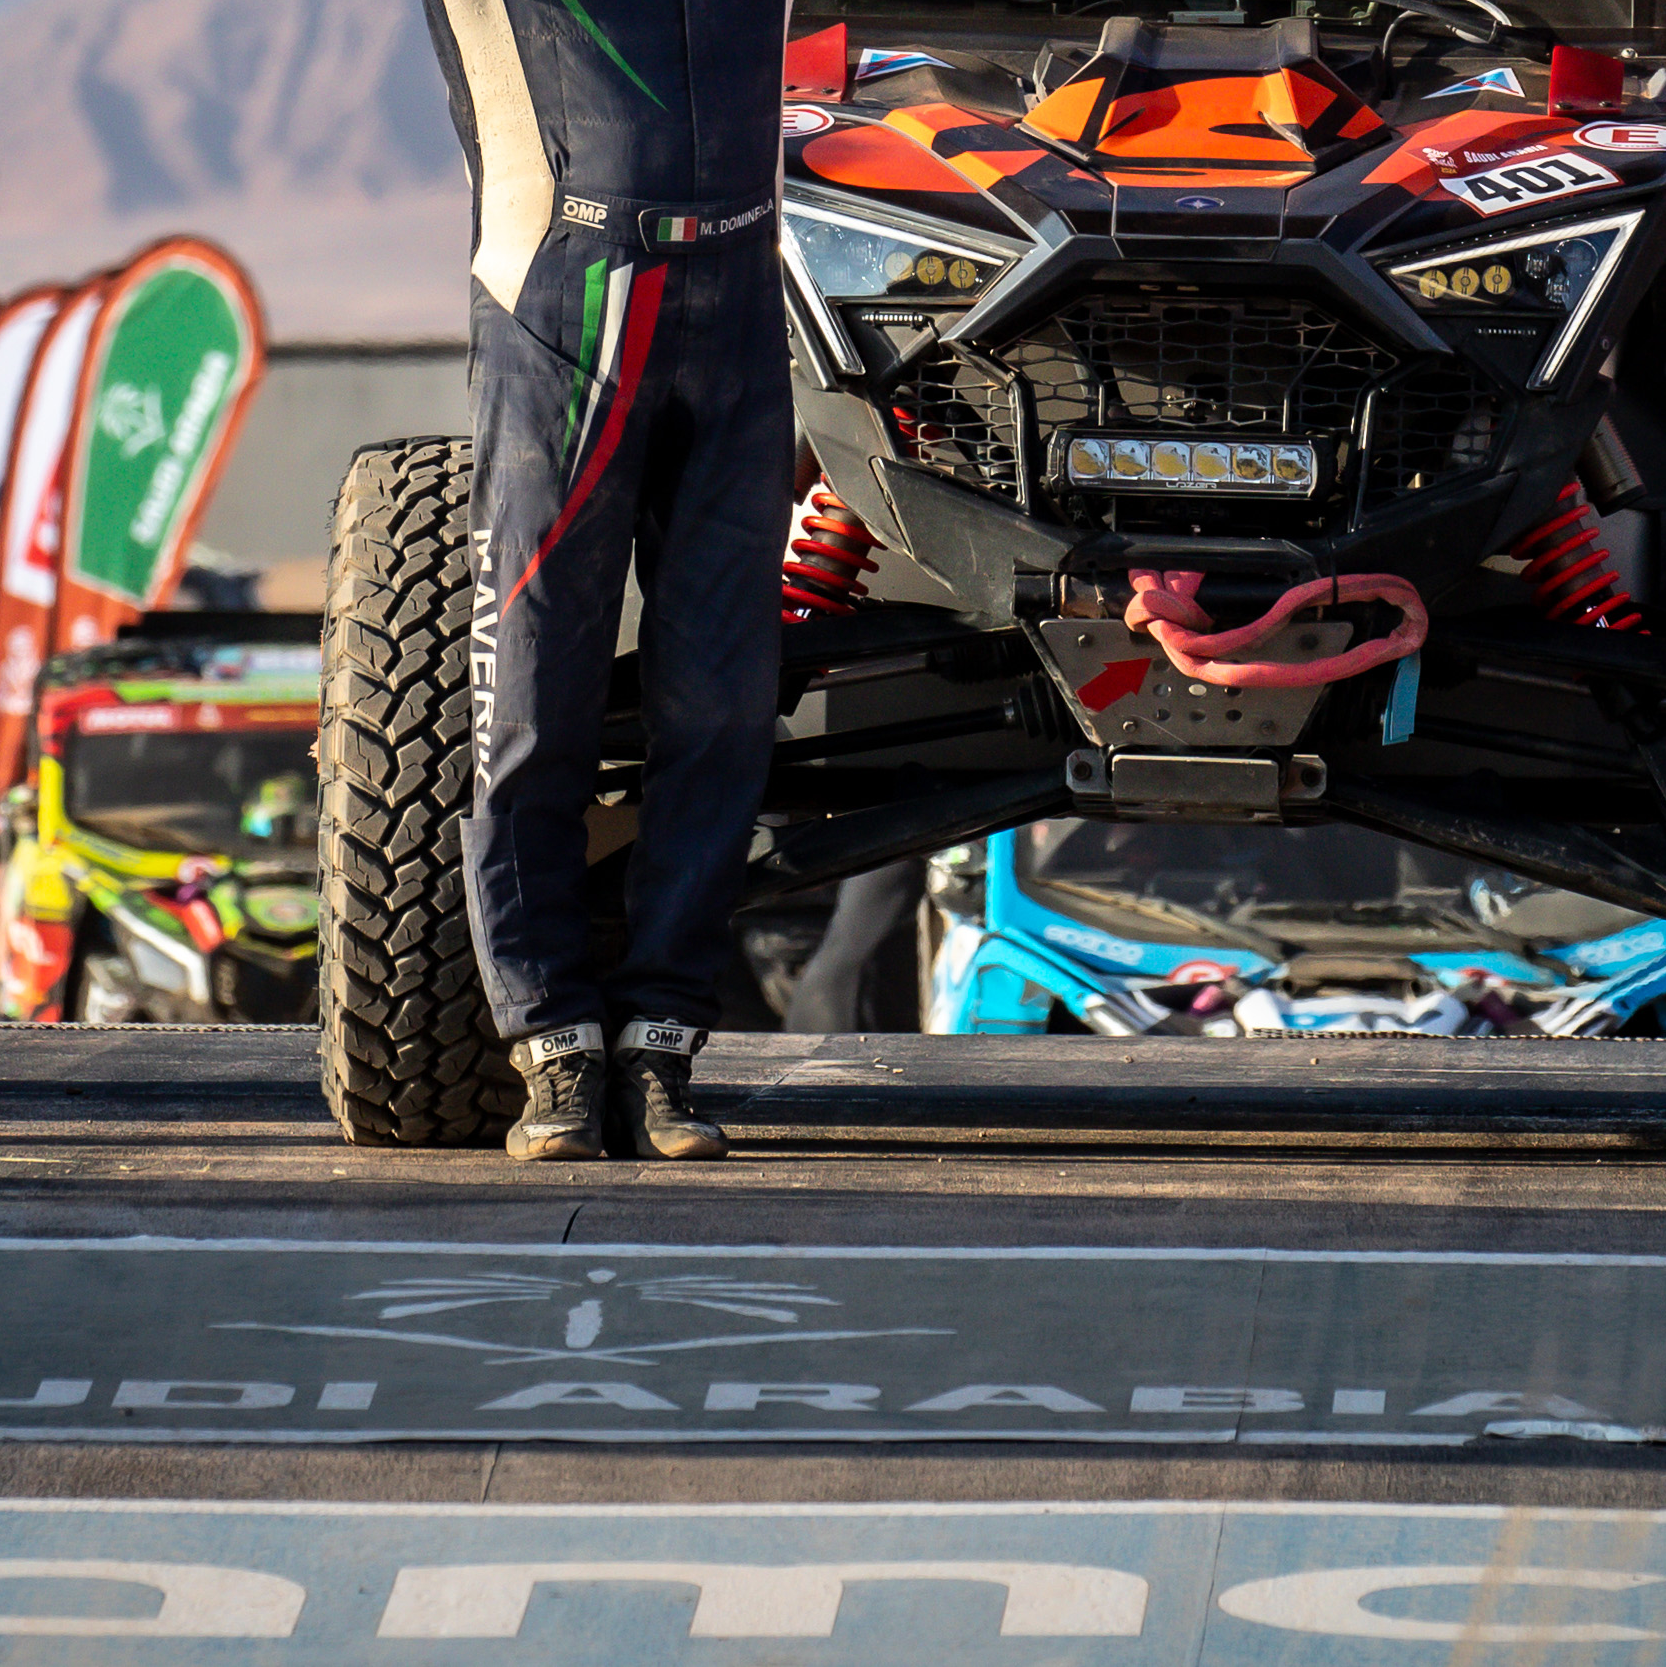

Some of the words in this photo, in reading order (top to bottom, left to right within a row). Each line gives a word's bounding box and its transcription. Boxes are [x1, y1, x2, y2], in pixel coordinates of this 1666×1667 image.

[1463, 150, 1501, 164] SAUDI
[1463, 159, 1605, 204] 401
[562, 200, 607, 224] OMP
[699, 221, 717, 236] M.
[541, 1031, 579, 1053] OMP
[646, 1028, 683, 1048] OMP
[480, 1380, 1600, 1417] ARABIA
